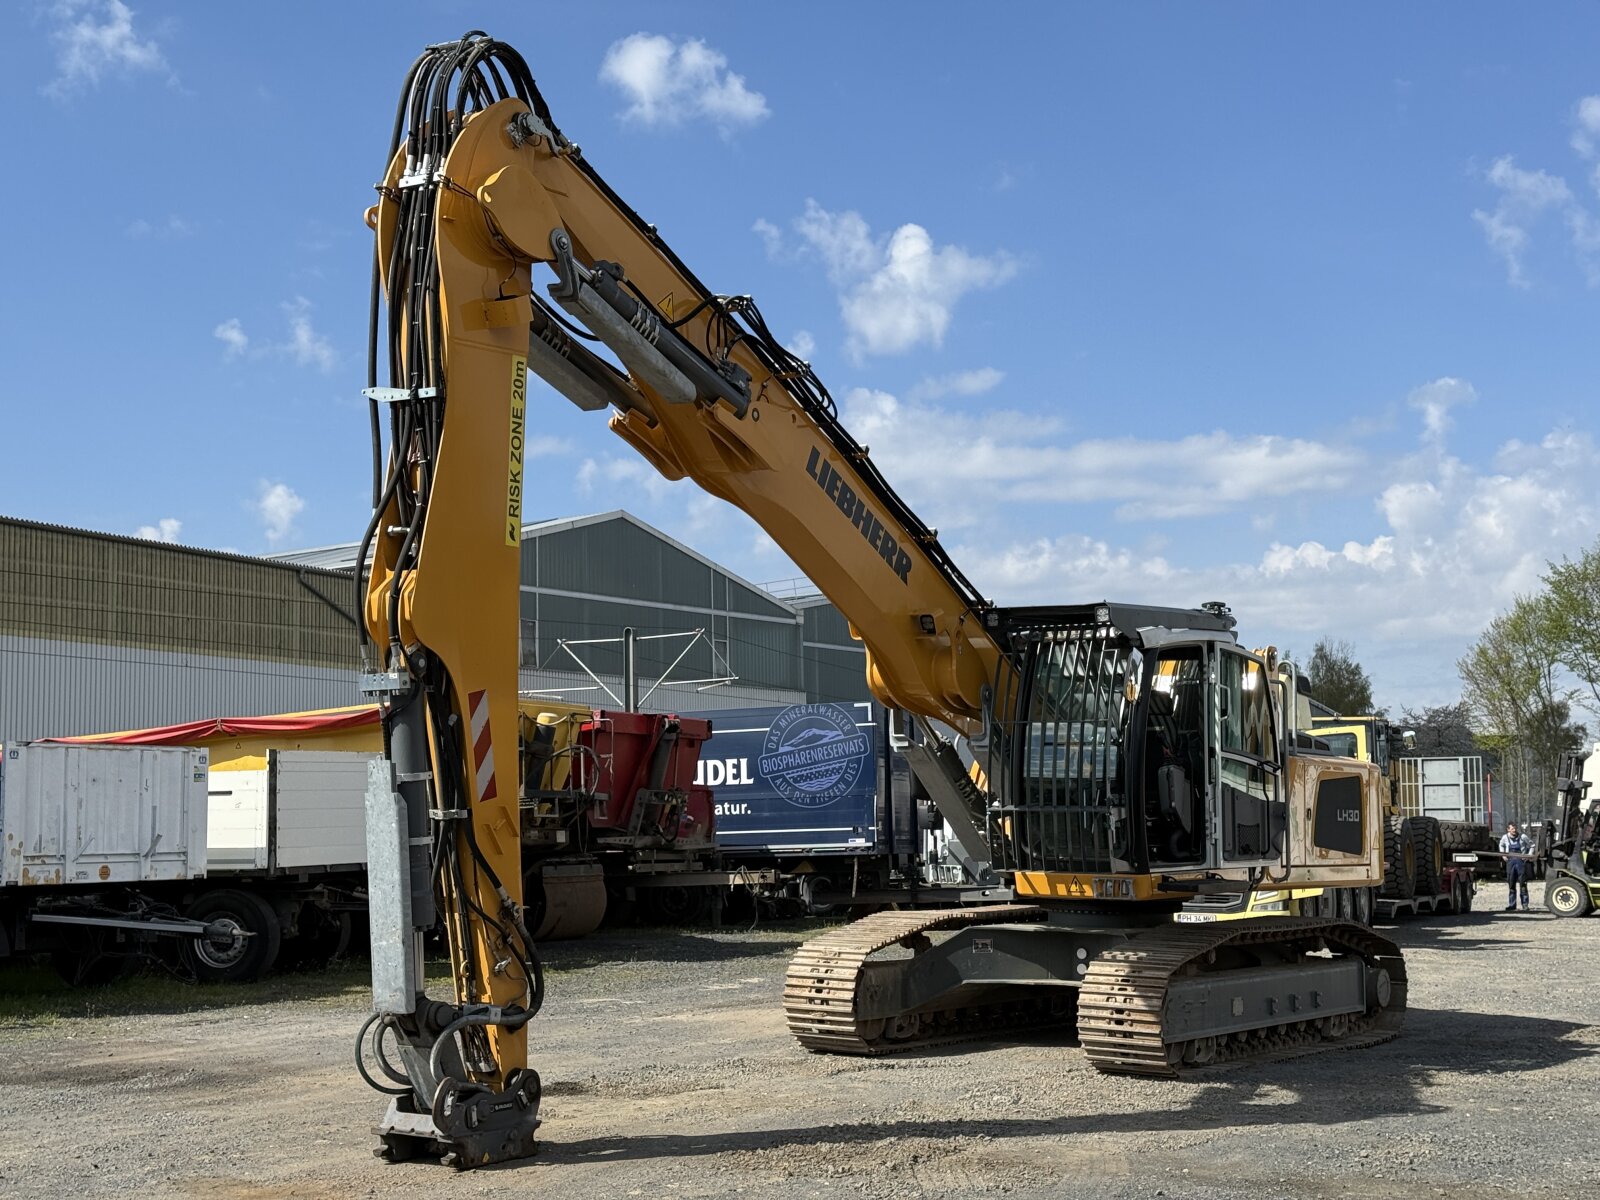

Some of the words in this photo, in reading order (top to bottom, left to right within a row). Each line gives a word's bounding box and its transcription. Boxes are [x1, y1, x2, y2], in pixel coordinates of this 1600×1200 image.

[513, 360, 525, 402] 20m
[511, 406, 523, 464] ZONE
[508, 470, 521, 518] RISK
[805, 445, 912, 587] LIEBHERR
[767, 729, 780, 749] DAS
[778, 705, 852, 732] MINERALWASSER
[762, 738, 865, 773] BIOSPHÄRENRESERVATS
[774, 777, 792, 795] AUS
[793, 791, 811, 804] DEN
[815, 782, 847, 804] TIEFEN
[844, 762, 858, 782] DES
[1337, 808, 1360, 822] LH30
